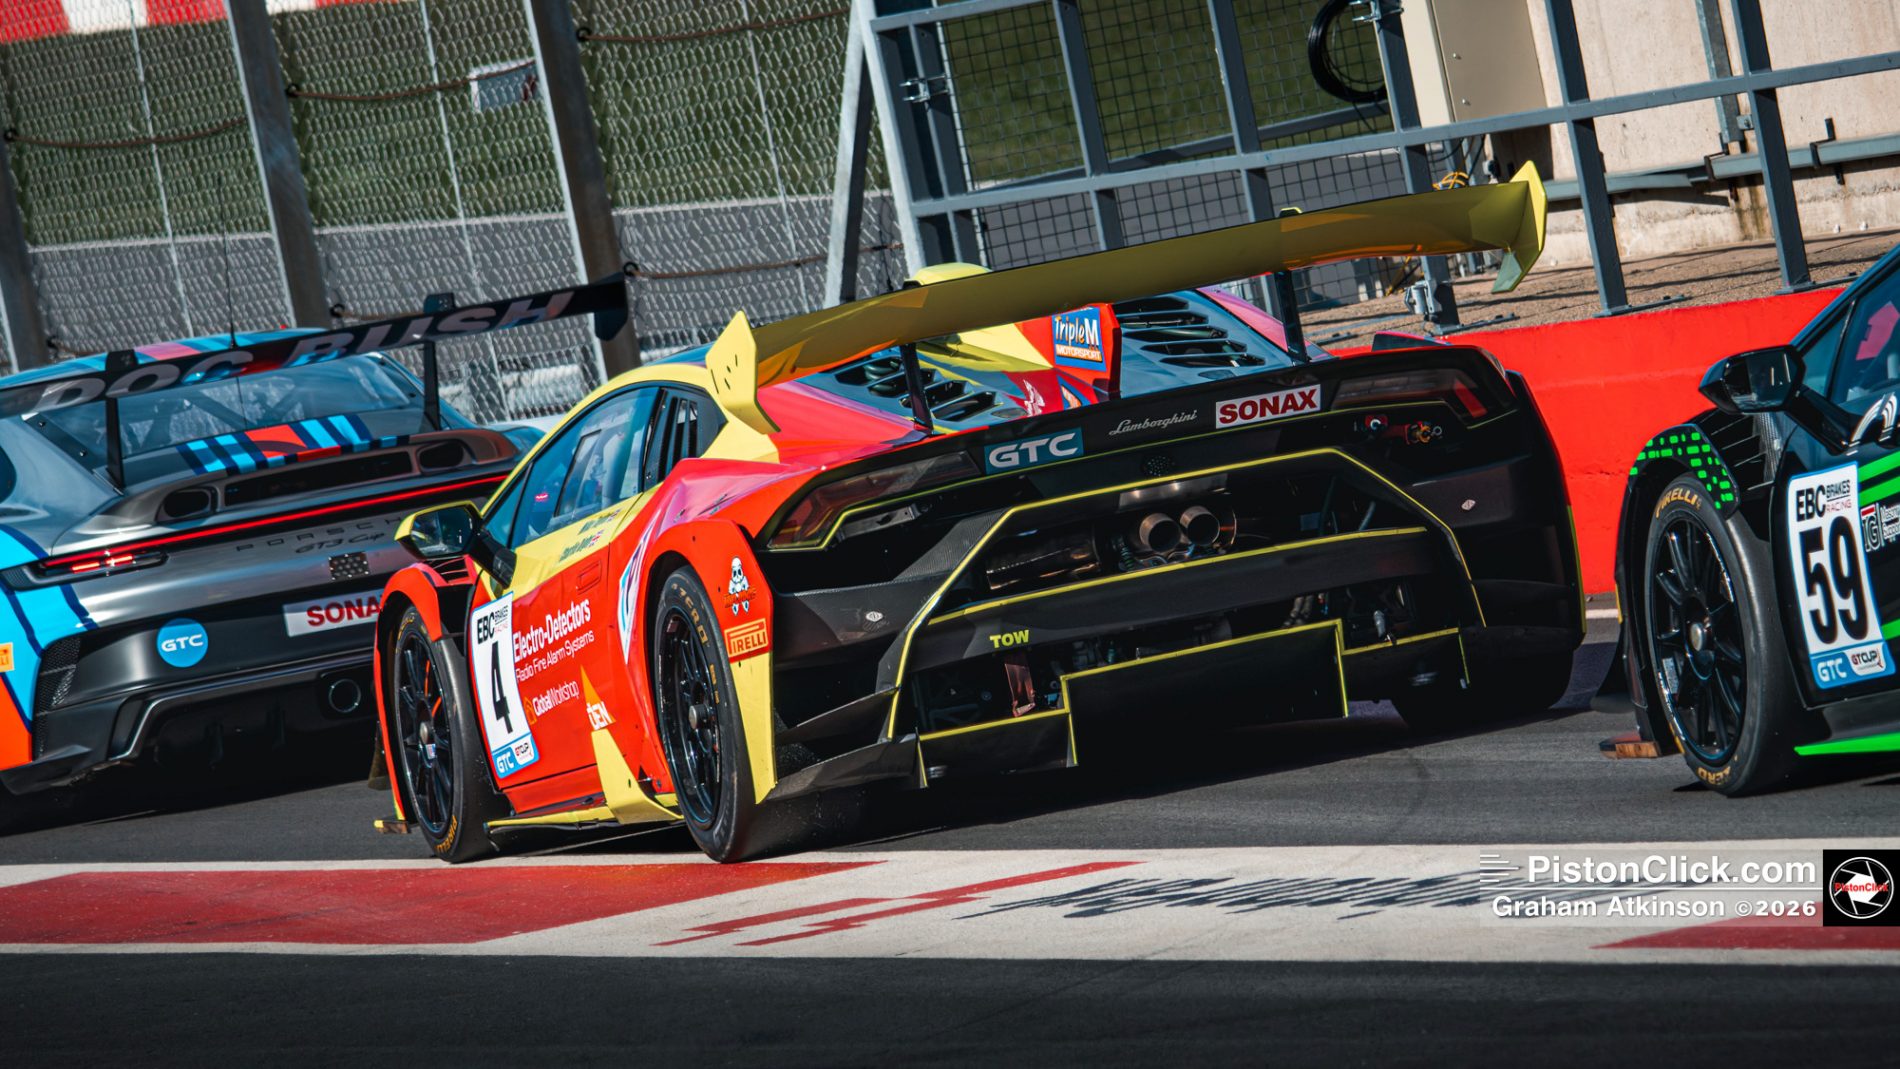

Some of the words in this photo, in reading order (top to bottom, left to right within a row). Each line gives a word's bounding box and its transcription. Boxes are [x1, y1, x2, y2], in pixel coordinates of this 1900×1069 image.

[32, 350, 254, 412] DOC
[280, 290, 575, 368] RUSH
[1056, 345, 1102, 361] MOTORSPORT
[1109, 409, 1197, 435] Lamborghini
[1219, 388, 1317, 424] SONAX
[988, 432, 1077, 468] GTC
[1796, 485, 1826, 522] EBC
[1826, 479, 1851, 498] BRAKES
[236, 516, 401, 552] PORSCH
[349, 532, 385, 545] Cup
[1798, 515, 1869, 645] 59
[306, 595, 384, 627] SONA
[477, 611, 495, 644] EBC
[161, 634, 203, 652] GTC
[513, 599, 591, 663] Electro-Detectors
[728, 621, 767, 656] PIRELLI
[990, 629, 1029, 648] TOW
[532, 657, 547, 675] Fire
[546, 647, 566, 667] Alarm
[565, 630, 594, 658] Systems
[491, 640, 514, 734] 4
[1817, 657, 1847, 683] GTC
[496, 751, 515, 773] GTC
